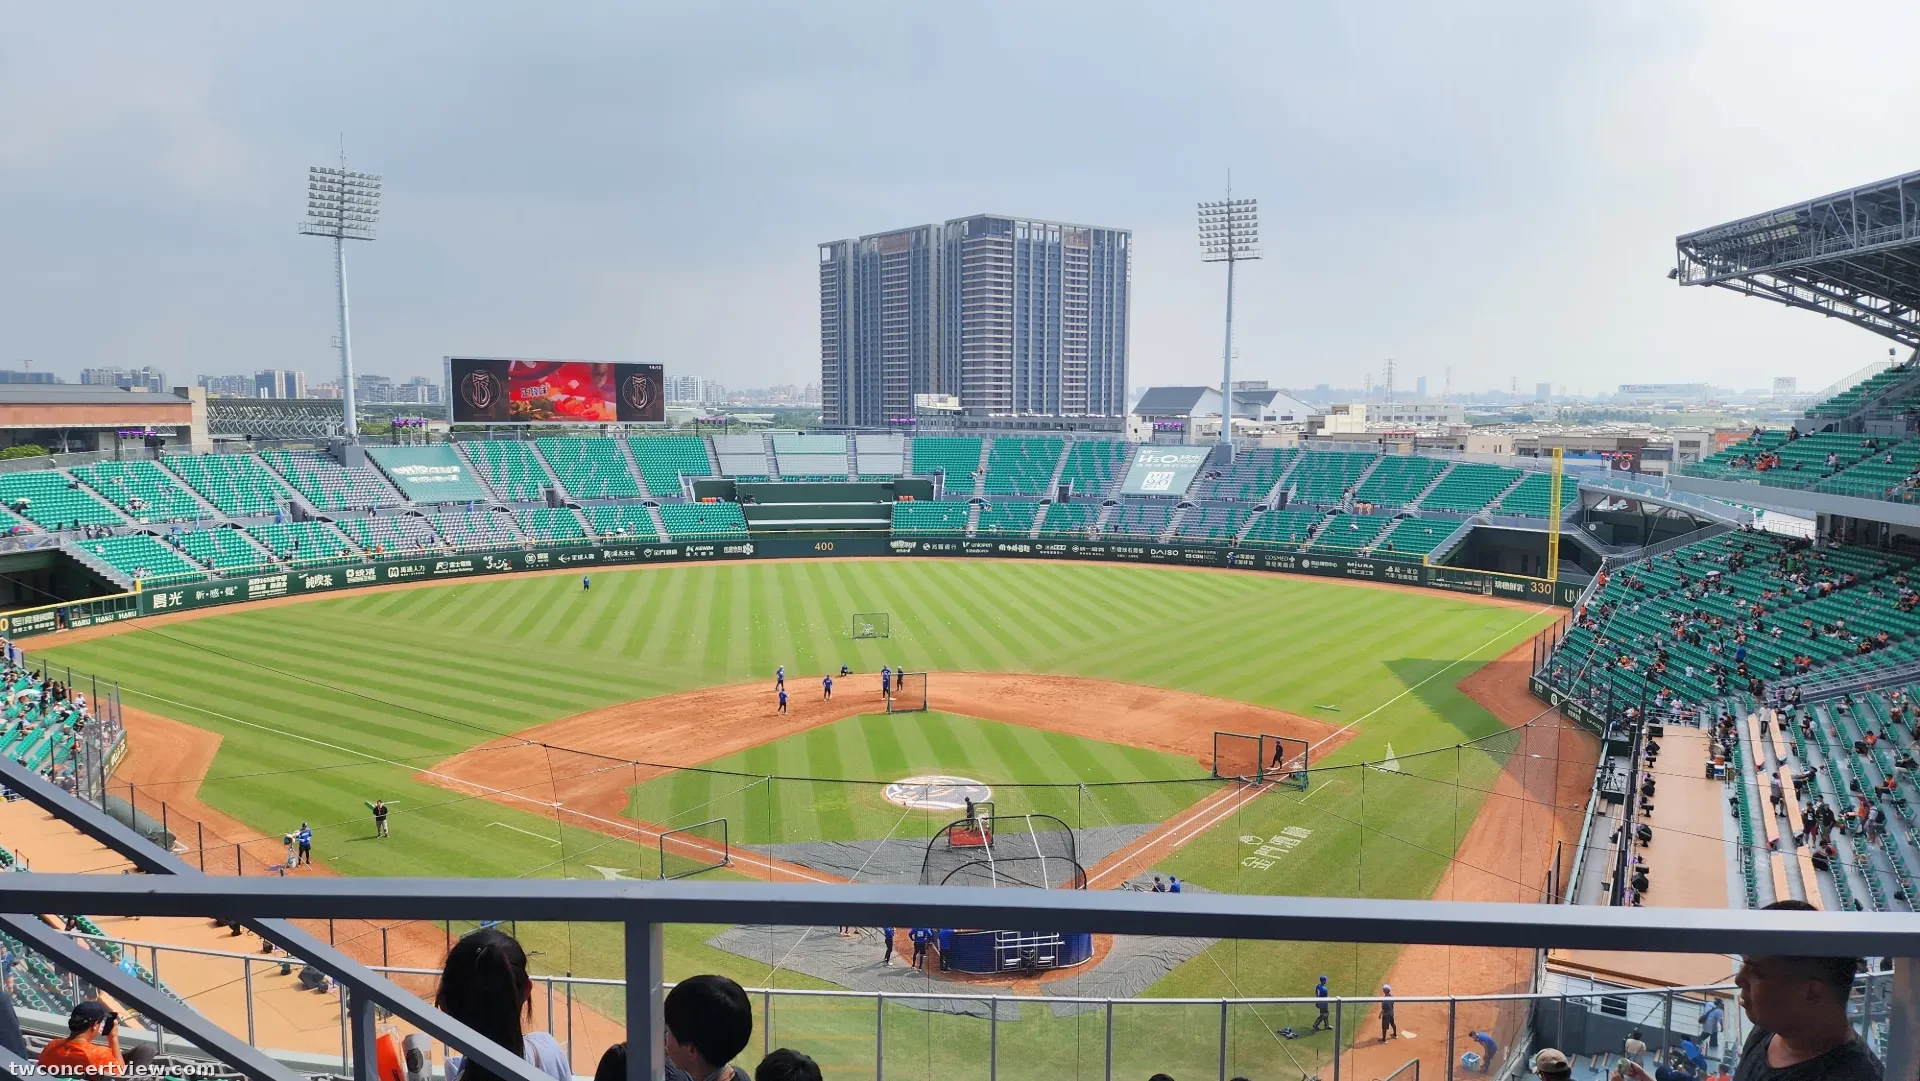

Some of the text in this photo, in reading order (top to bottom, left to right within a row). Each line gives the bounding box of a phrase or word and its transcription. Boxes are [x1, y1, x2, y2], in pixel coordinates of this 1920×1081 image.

[814, 542, 834, 551] 400
[1150, 548, 1179, 556] DAISO
[305, 574, 333, 589] 純喫茶
[1530, 581, 1551, 595] 330
[72, 611, 137, 628] HARU HARU HARU
